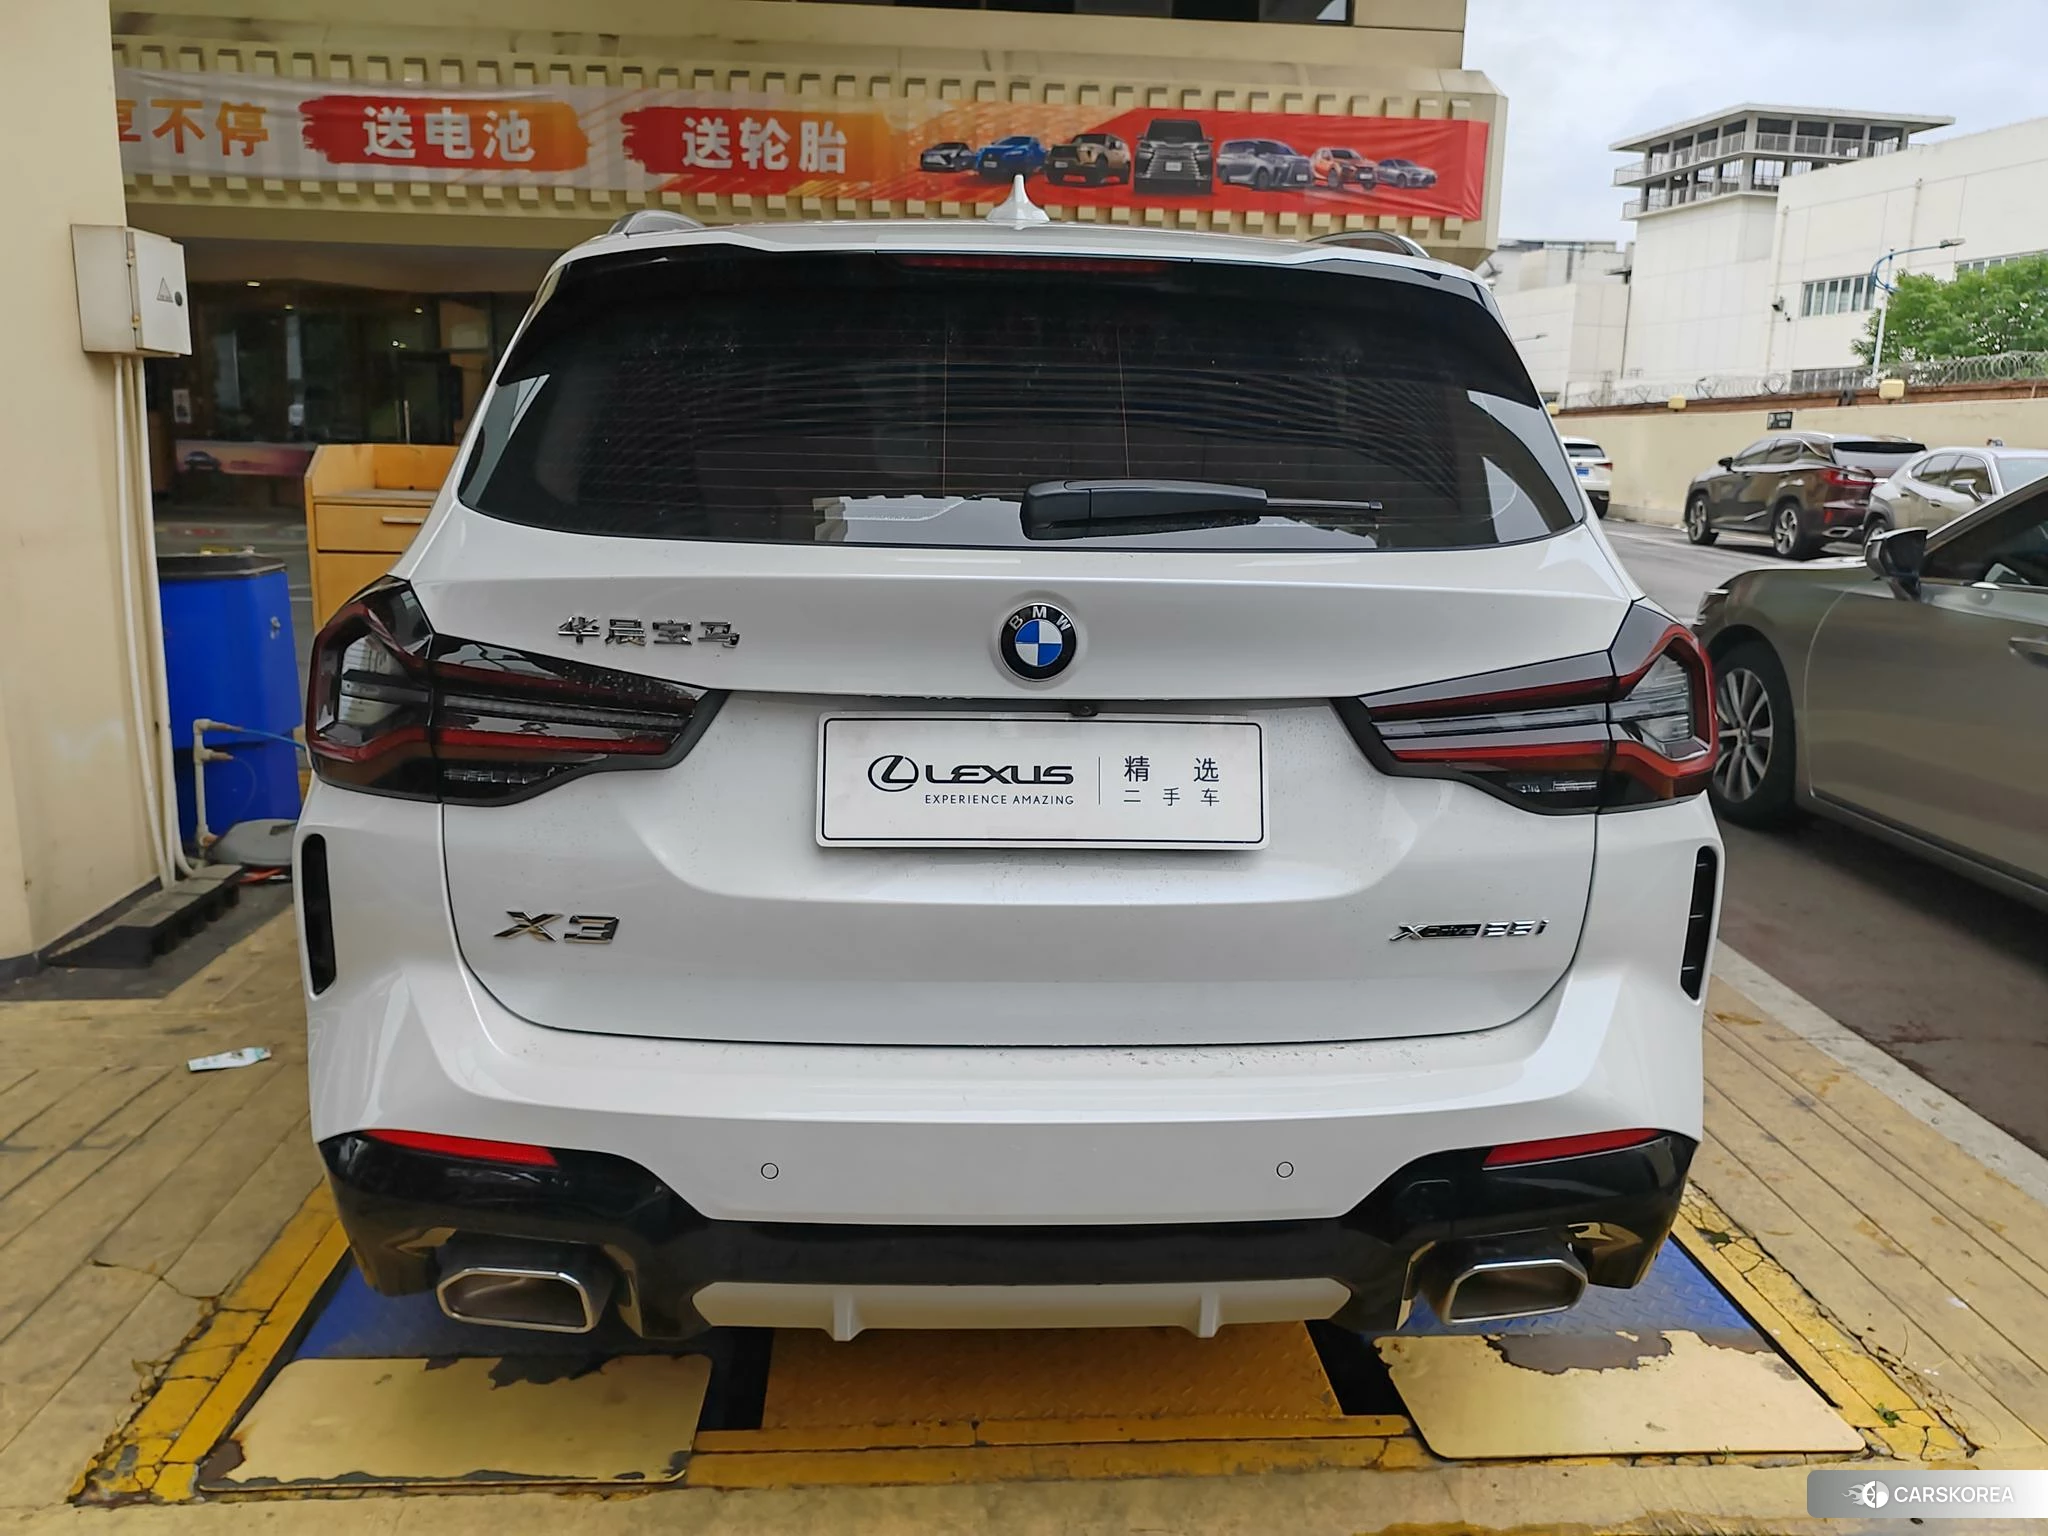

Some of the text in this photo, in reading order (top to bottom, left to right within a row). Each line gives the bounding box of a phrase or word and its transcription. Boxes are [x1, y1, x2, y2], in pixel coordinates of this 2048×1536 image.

[362, 106, 536, 162] 送电池
[682, 116, 848, 174] 送轮胎
[1008, 606, 1072, 631] BMW
[558, 616, 740, 648] 华晨宝马
[925, 764, 1074, 785] LEXUS
[1124, 755, 1219, 782] 精选
[925, 794, 1074, 805] EXPERIENCE AMAZING
[1123, 787, 1220, 806] 二手车
[493, 910, 620, 944] X3
